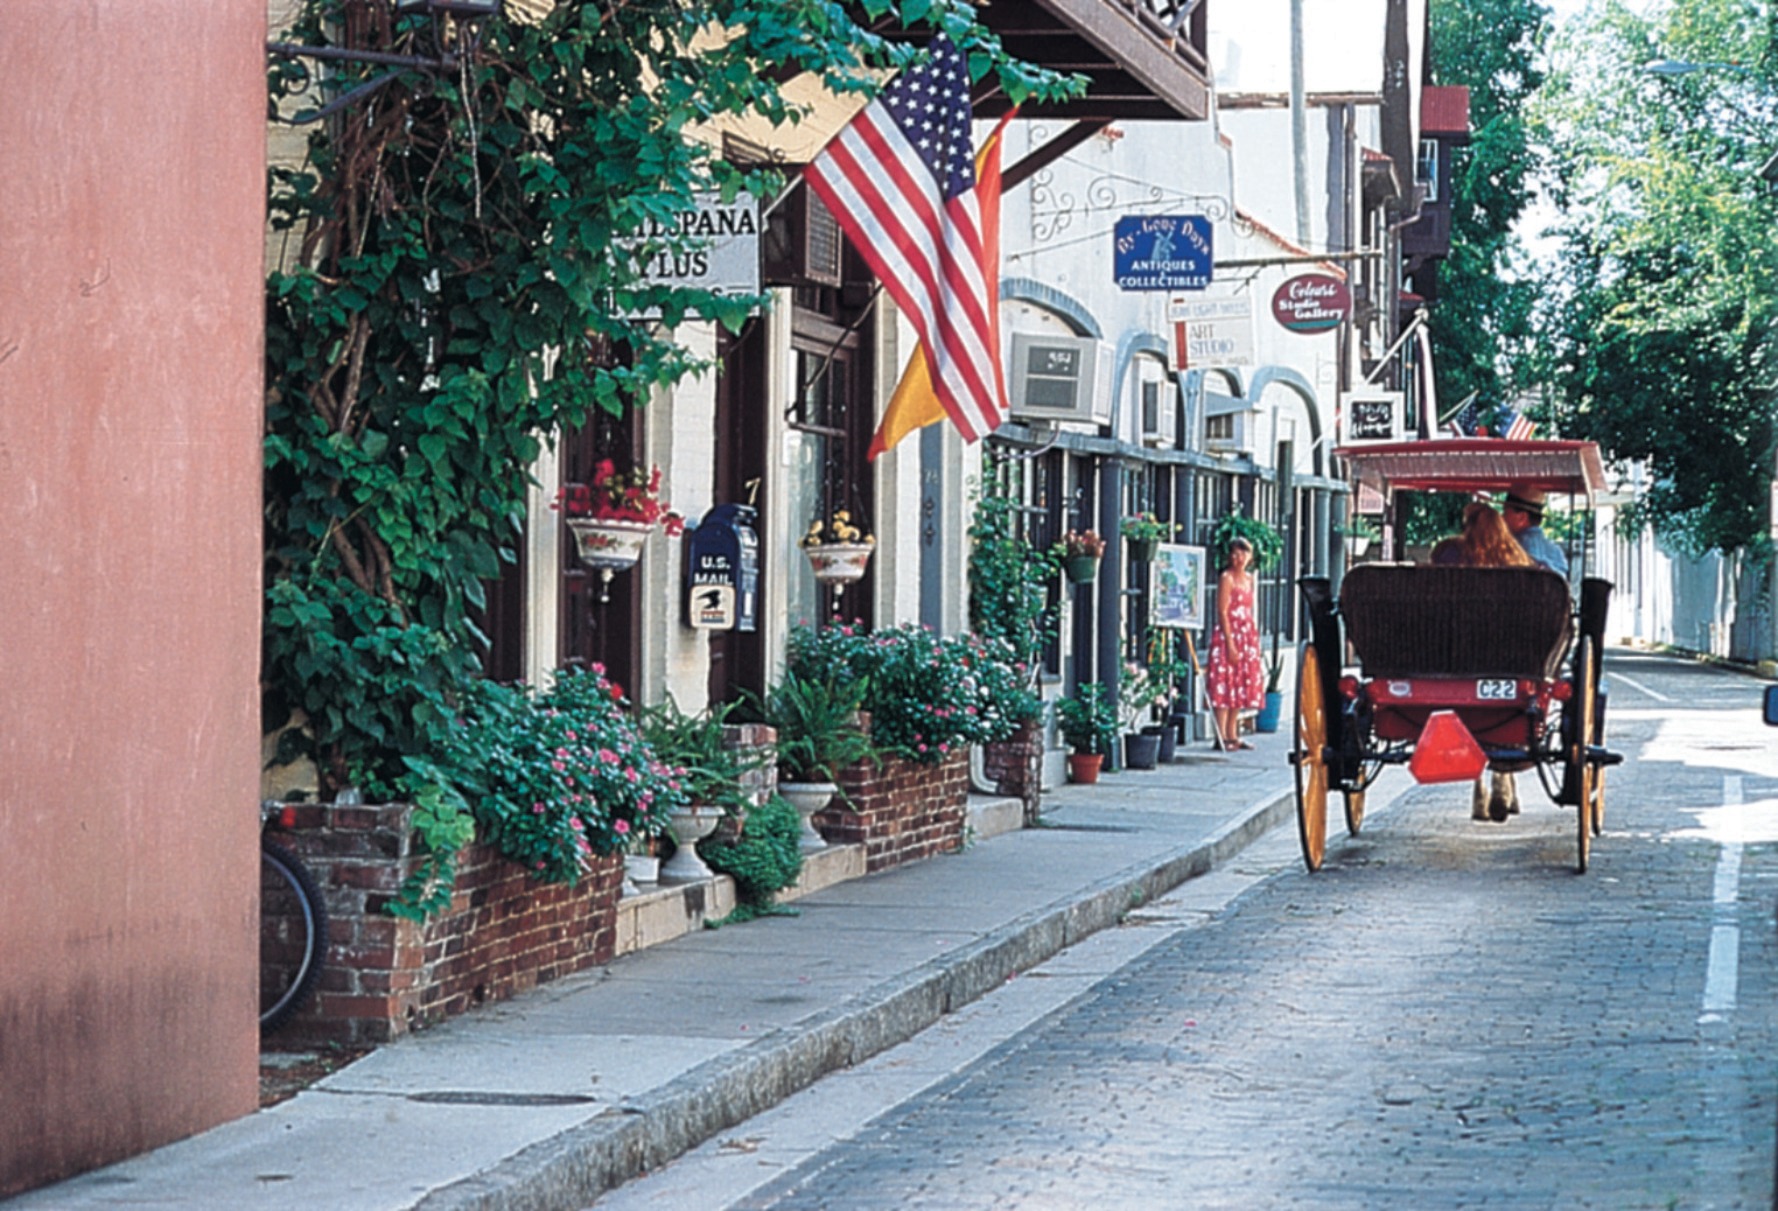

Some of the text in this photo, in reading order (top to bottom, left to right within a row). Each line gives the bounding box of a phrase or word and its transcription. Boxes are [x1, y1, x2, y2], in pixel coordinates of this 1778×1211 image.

[1131, 260, 1196, 272] ANTIQUES
[1119, 276, 1208, 287] COLLECTIBLES
[1279, 299, 1320, 311] Studio
[1295, 308, 1344, 320] Gallery
[1190, 324, 1214, 339] ART
[1190, 339, 1235, 355] STUDIO
[701, 556, 731, 569] U.S.
[694, 573, 733, 585] MAIL
[1479, 681, 1514, 697] C22
